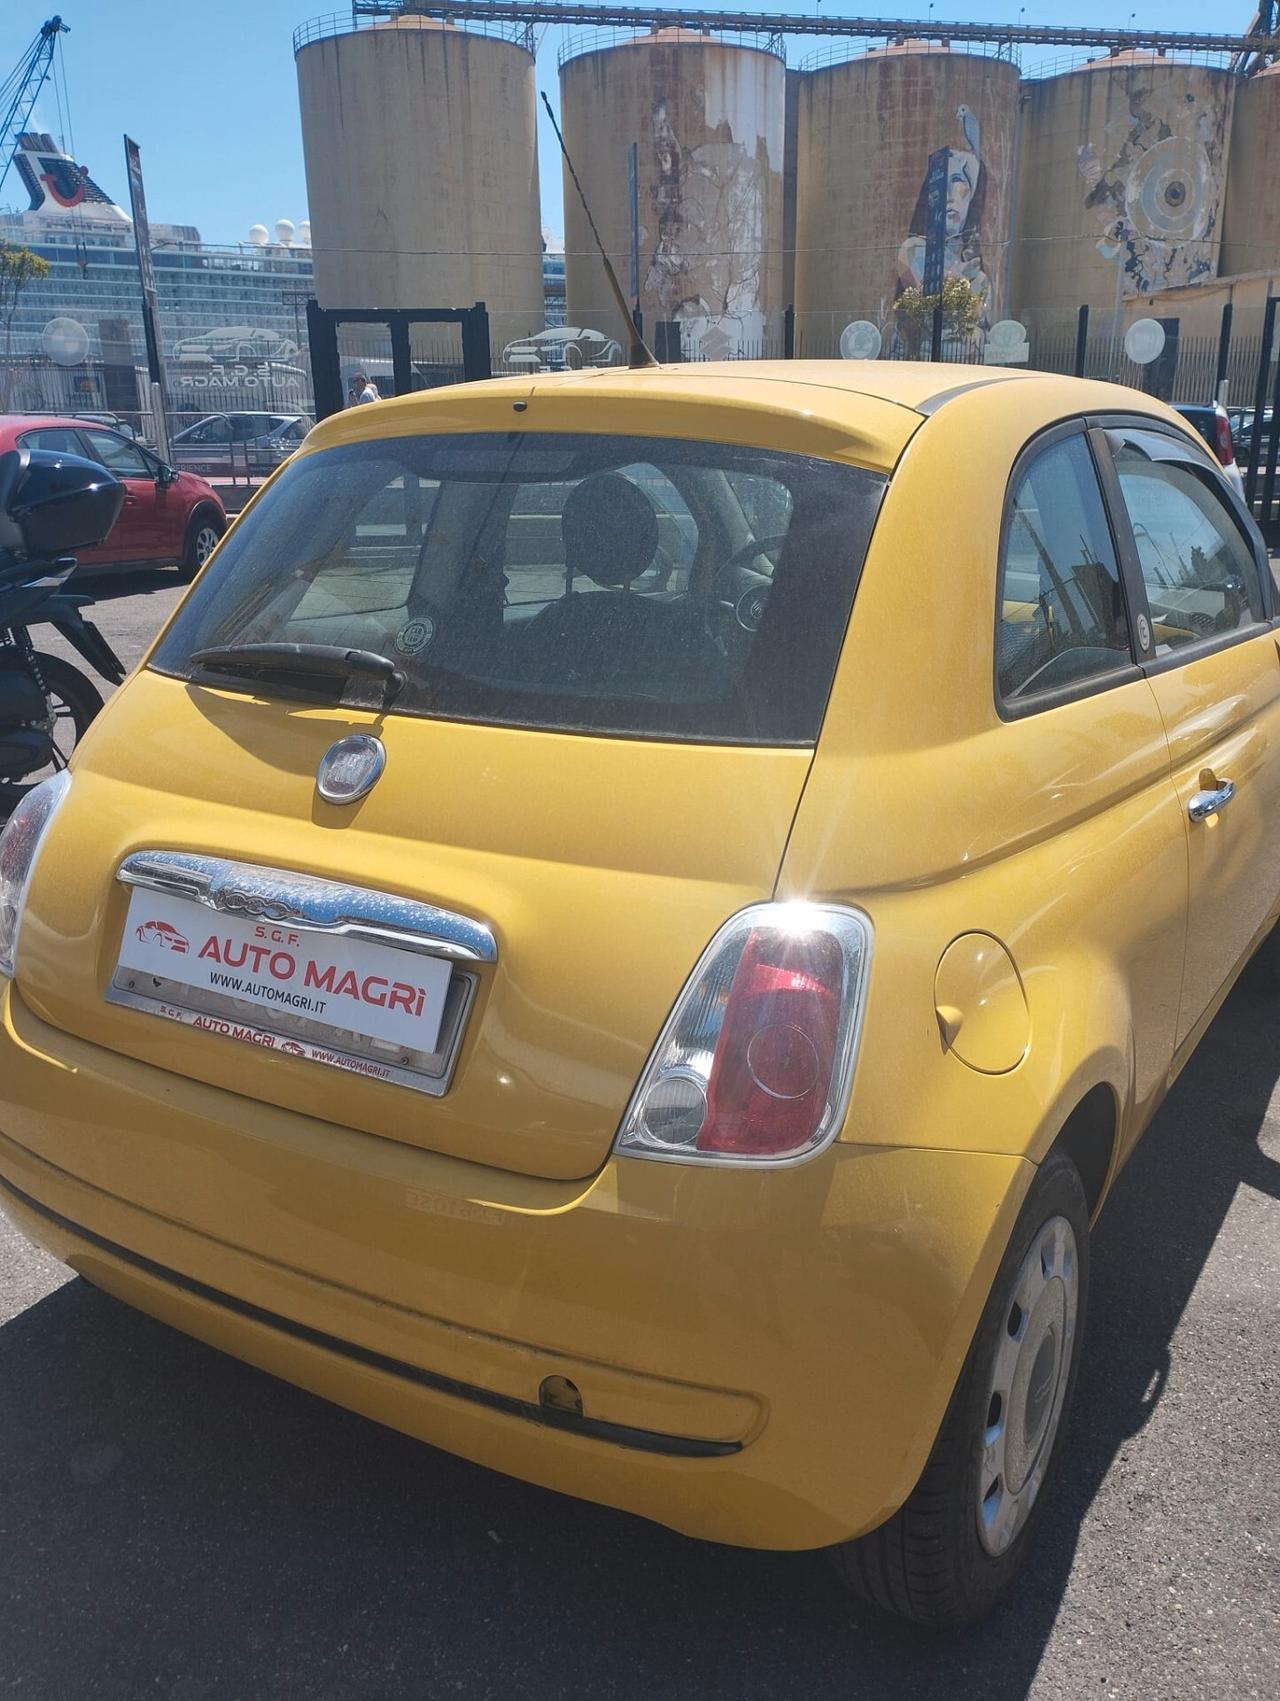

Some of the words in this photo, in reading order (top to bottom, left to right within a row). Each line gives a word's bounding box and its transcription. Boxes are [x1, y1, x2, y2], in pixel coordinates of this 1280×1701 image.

[171, 464, 213, 473] PERIENCE
[198, 935, 296, 980] AUTO
[210, 971, 327, 1014] WWW.AUTOMAGRI.IT
[192, 1015, 230, 1034] AUTO
[311, 1048, 391, 1078] WWW.AUTOMAGRI.IT
